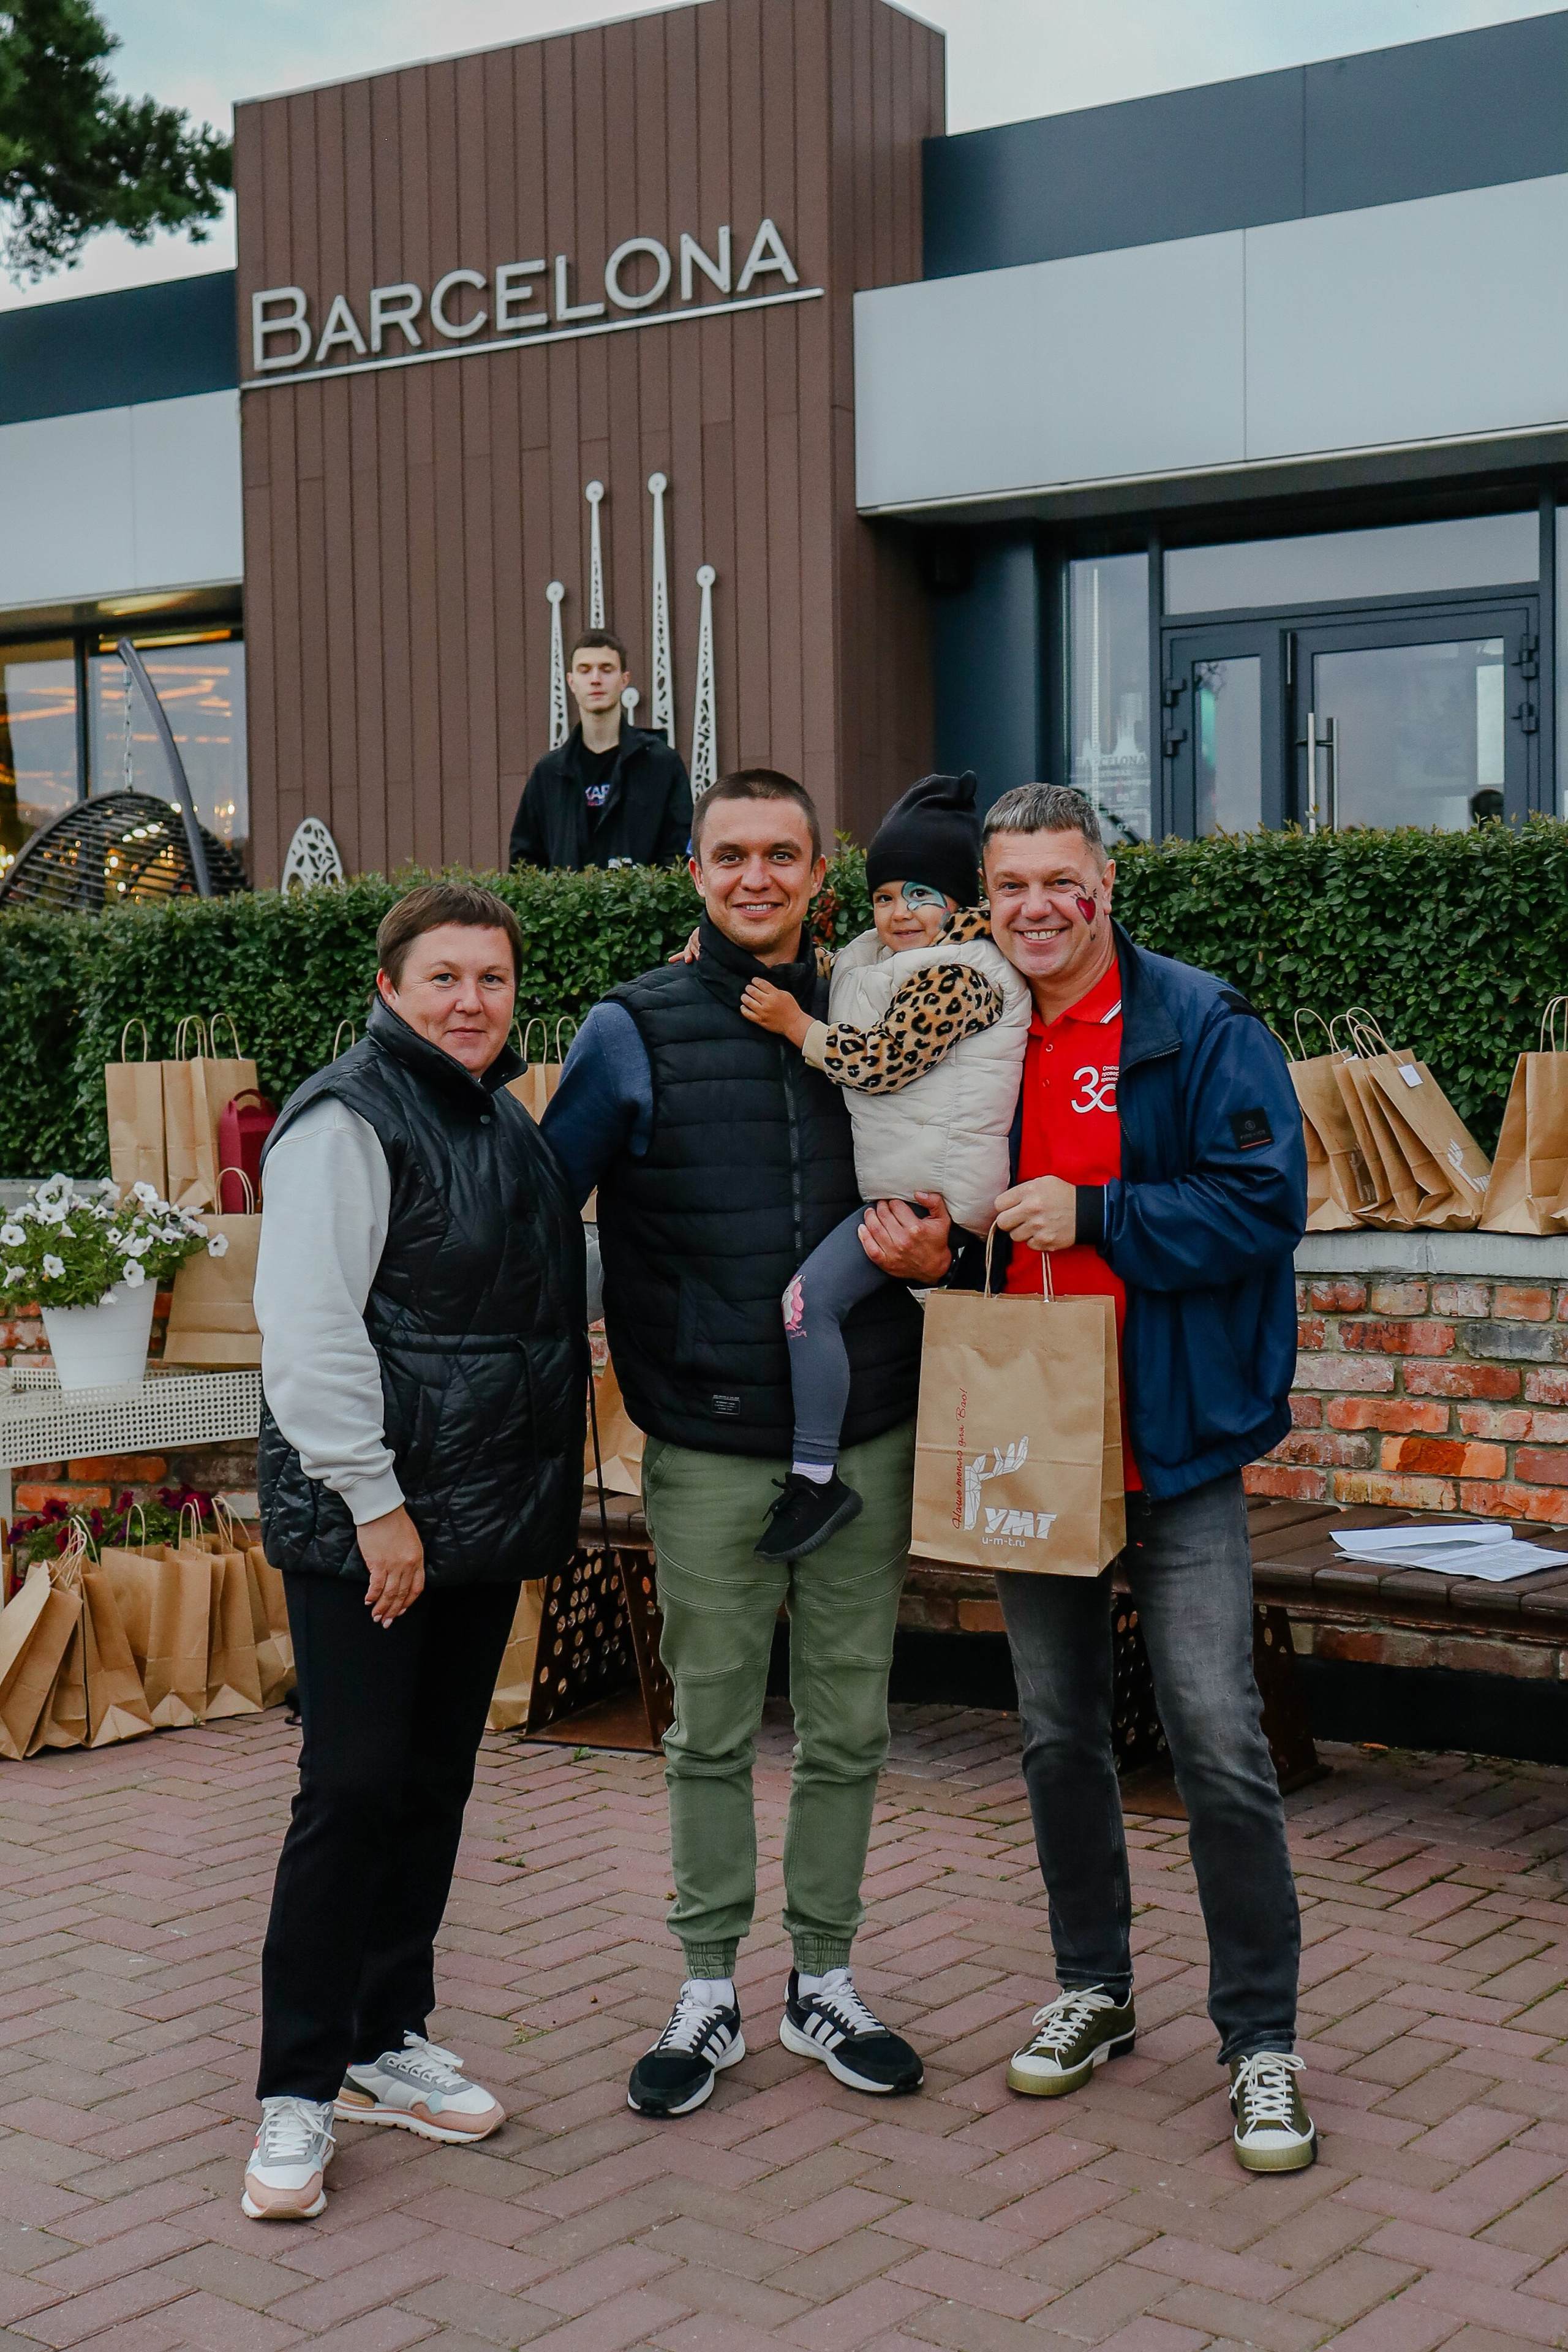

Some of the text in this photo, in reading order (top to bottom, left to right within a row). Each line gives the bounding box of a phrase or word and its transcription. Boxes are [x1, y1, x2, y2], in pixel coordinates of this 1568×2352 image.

[251, 218, 799, 370] BARCELONA
[957, 1425, 967, 1447] для
[982, 1536, 1026, 1548] u-m-t.ru
